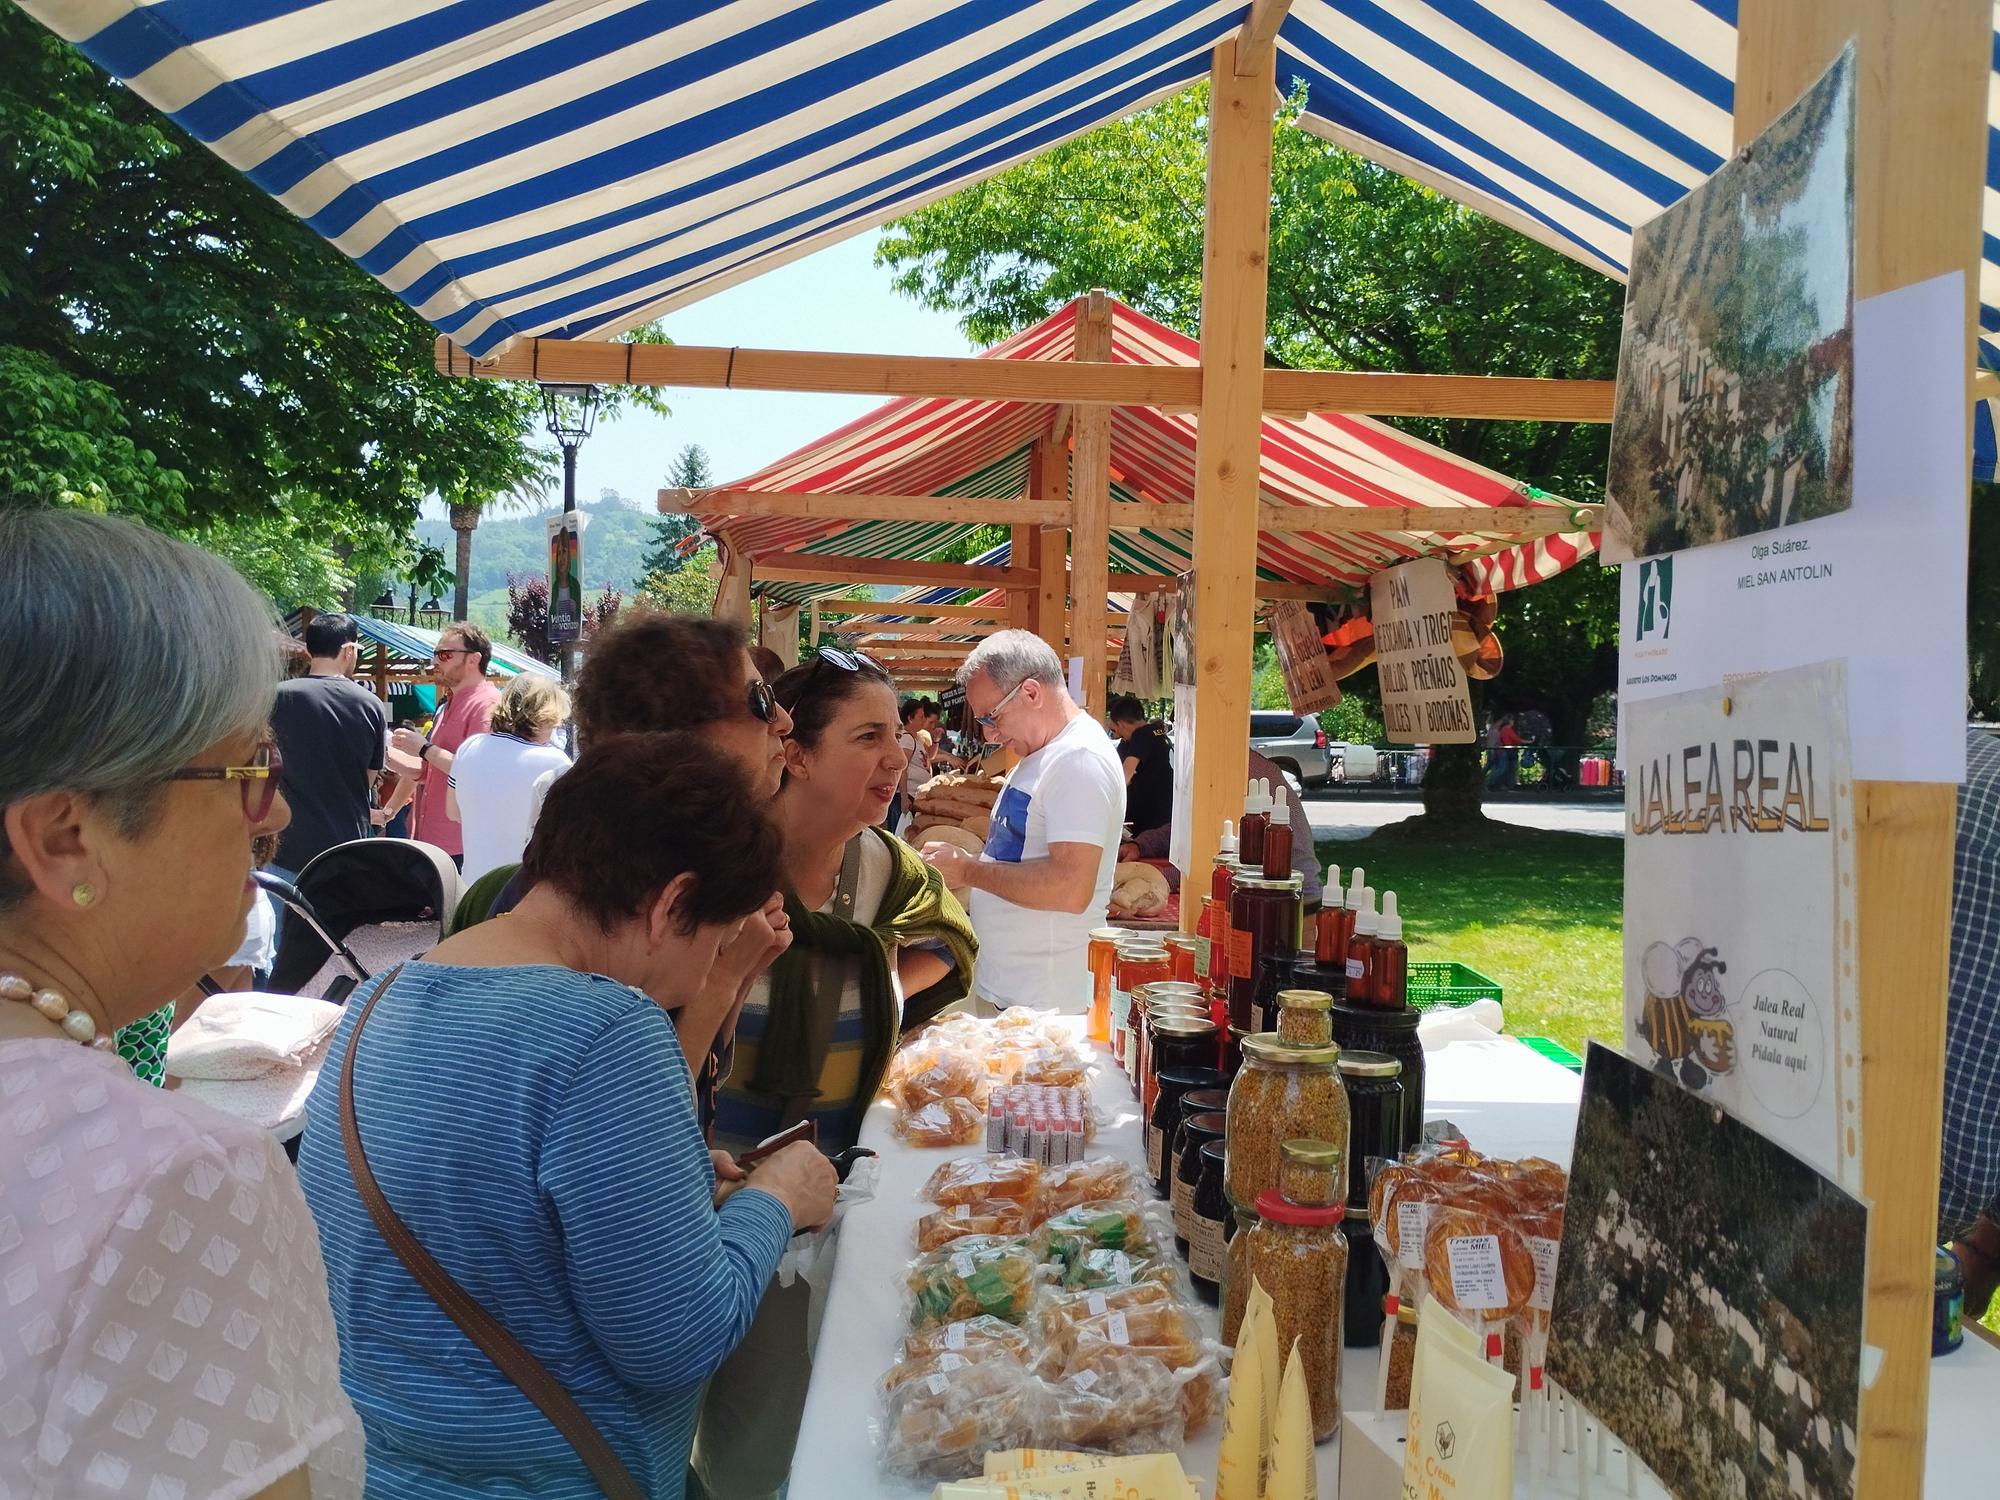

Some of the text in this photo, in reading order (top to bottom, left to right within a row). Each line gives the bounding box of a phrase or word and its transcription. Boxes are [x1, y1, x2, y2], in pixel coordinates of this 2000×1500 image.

[1752, 545, 1769, 560] Olga
[1737, 563, 1832, 589] MIEL SAN ANTOLIN
[1389, 575, 1411, 609] PAN
[1413, 620, 1422, 648] Y
[1411, 654, 1457, 691] PREÑAOS
[1413, 704, 1423, 732] Y
[1425, 695, 1470, 733] BOROÑAS
[1632, 739, 1830, 835] JALEA REAL
[1753, 994, 1805, 1020] Jalea Real
[1760, 1020, 1798, 1043] Natural
